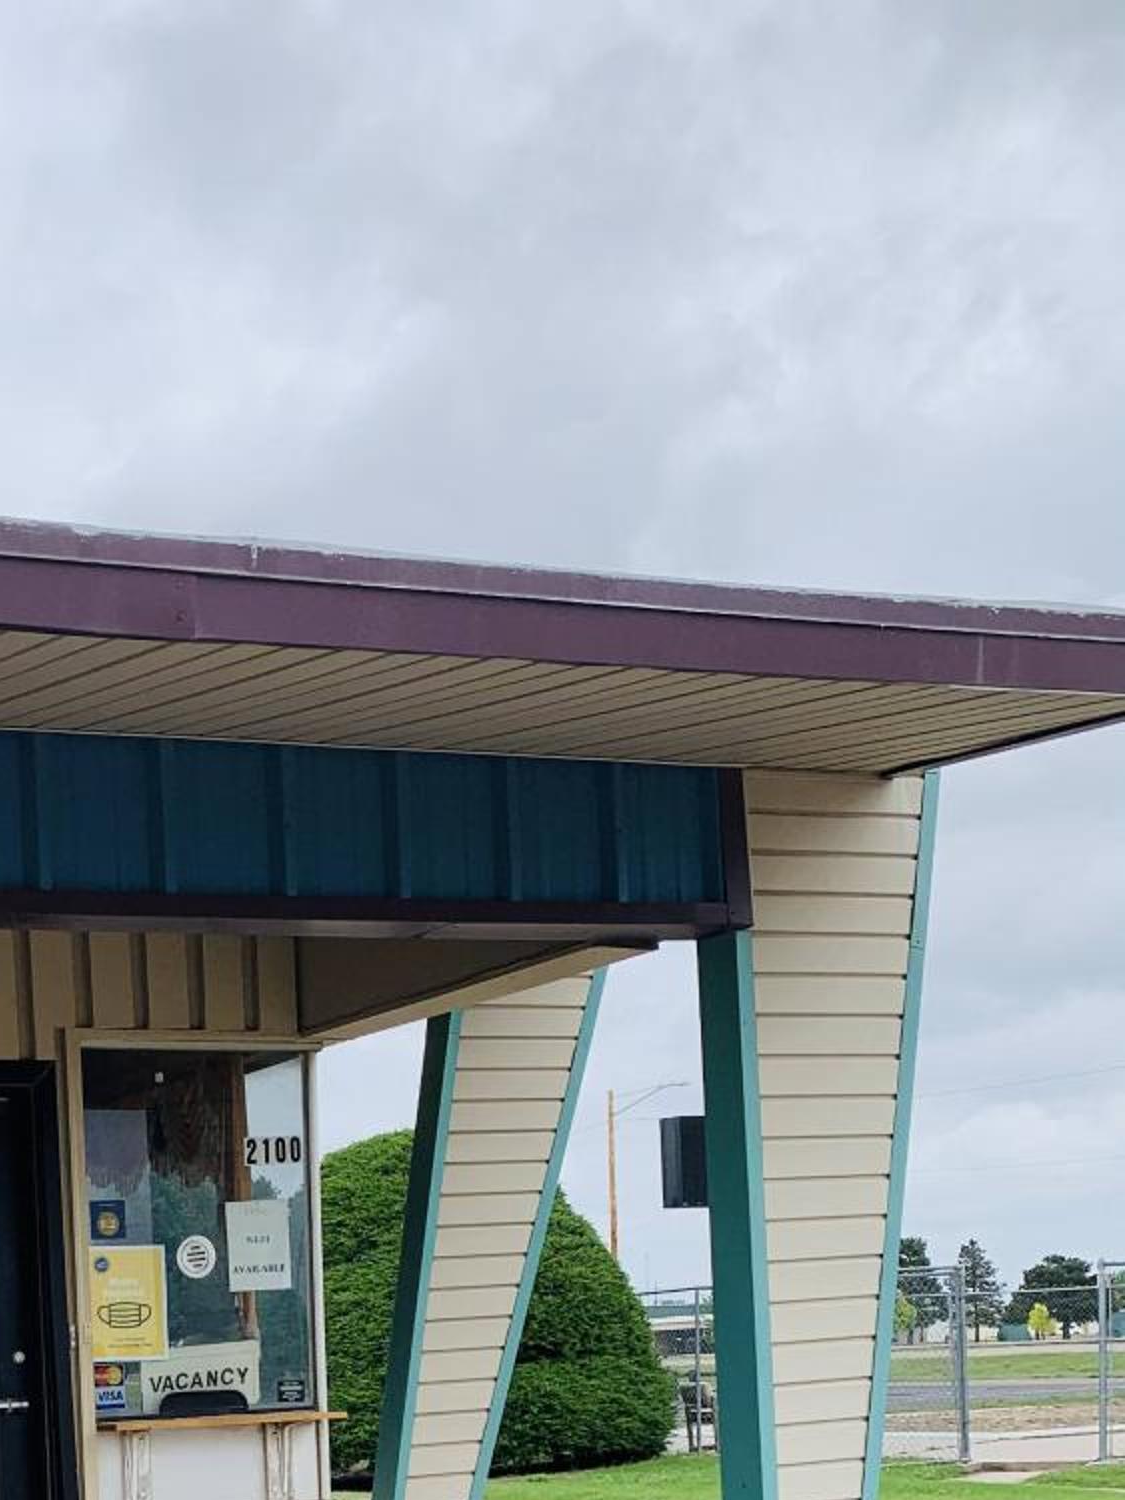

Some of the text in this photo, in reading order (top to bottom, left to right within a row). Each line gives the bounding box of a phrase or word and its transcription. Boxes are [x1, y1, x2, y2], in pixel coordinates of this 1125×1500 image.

[246, 1135, 301, 1165] 2100
[150, 1366, 250, 1394] VACANCY
[97, 1389, 124, 1402] VISA
